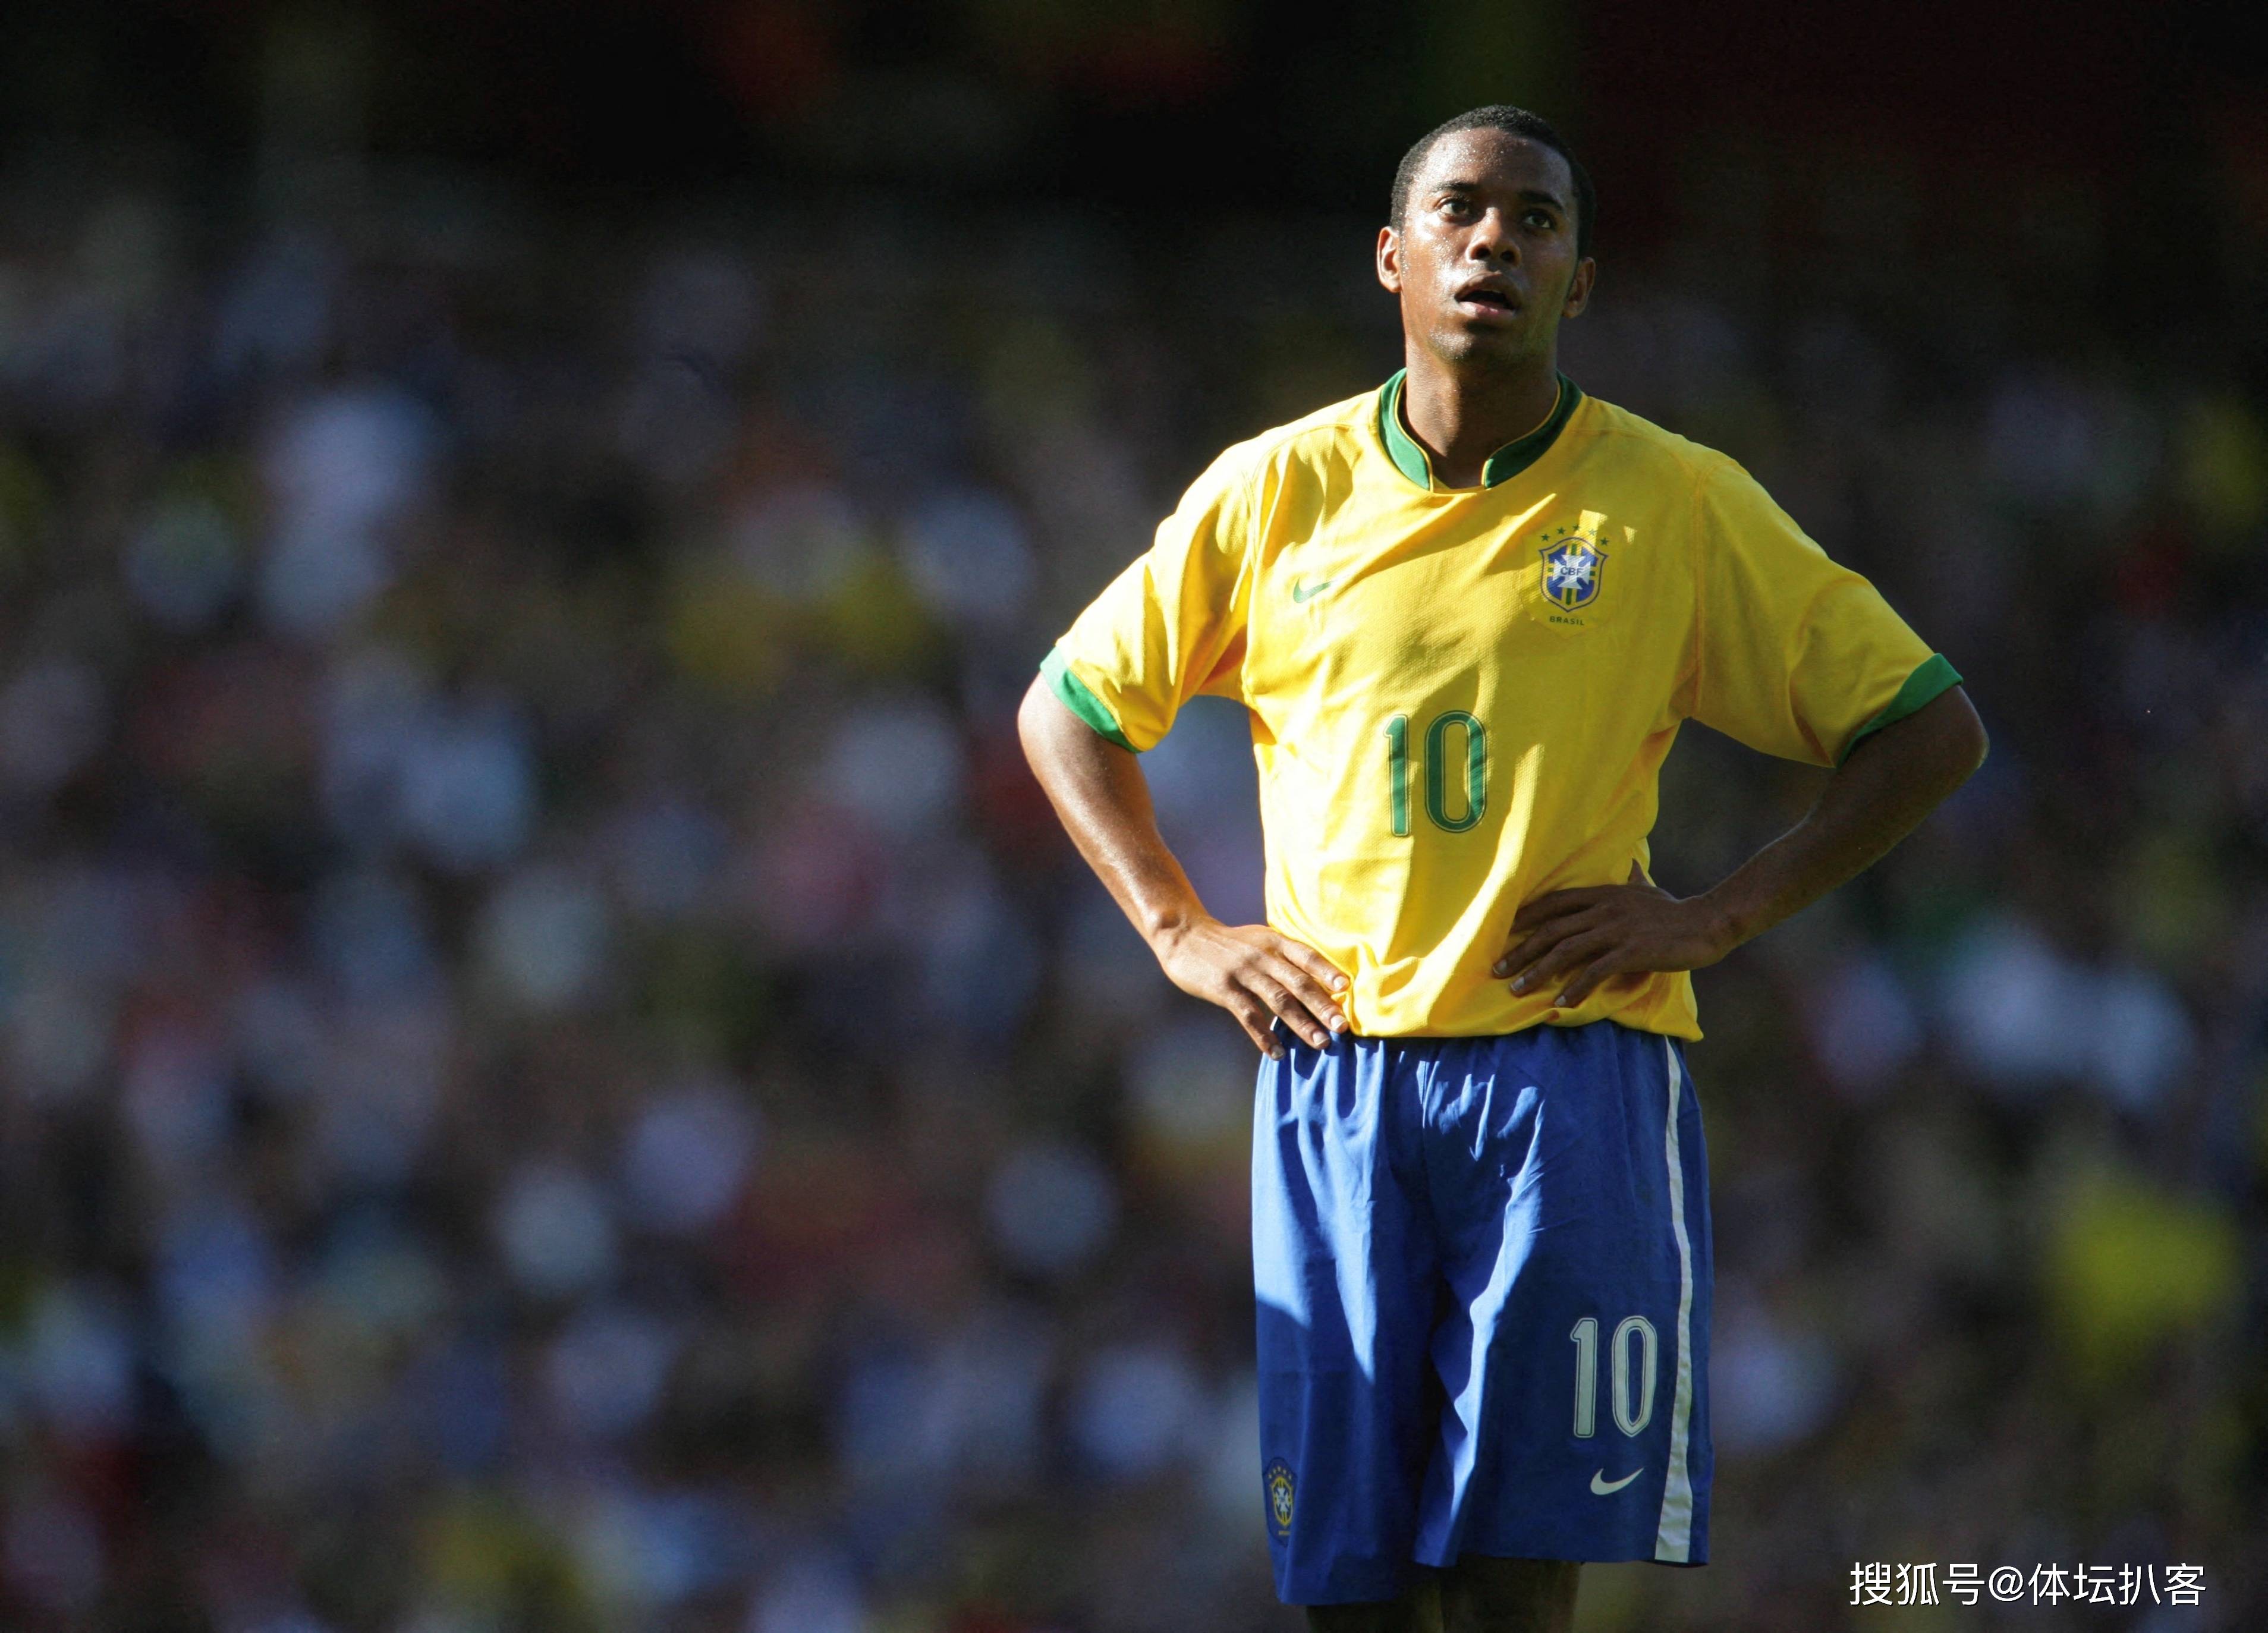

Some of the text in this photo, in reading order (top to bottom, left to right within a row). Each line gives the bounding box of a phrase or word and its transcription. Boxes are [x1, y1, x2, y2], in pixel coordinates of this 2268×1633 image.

[1561, 567, 1584, 575] CBF
[1550, 616, 1584, 625] BRASIL
[1383, 710, 1487, 837] 10
[1570, 1316, 1657, 1437] 10
